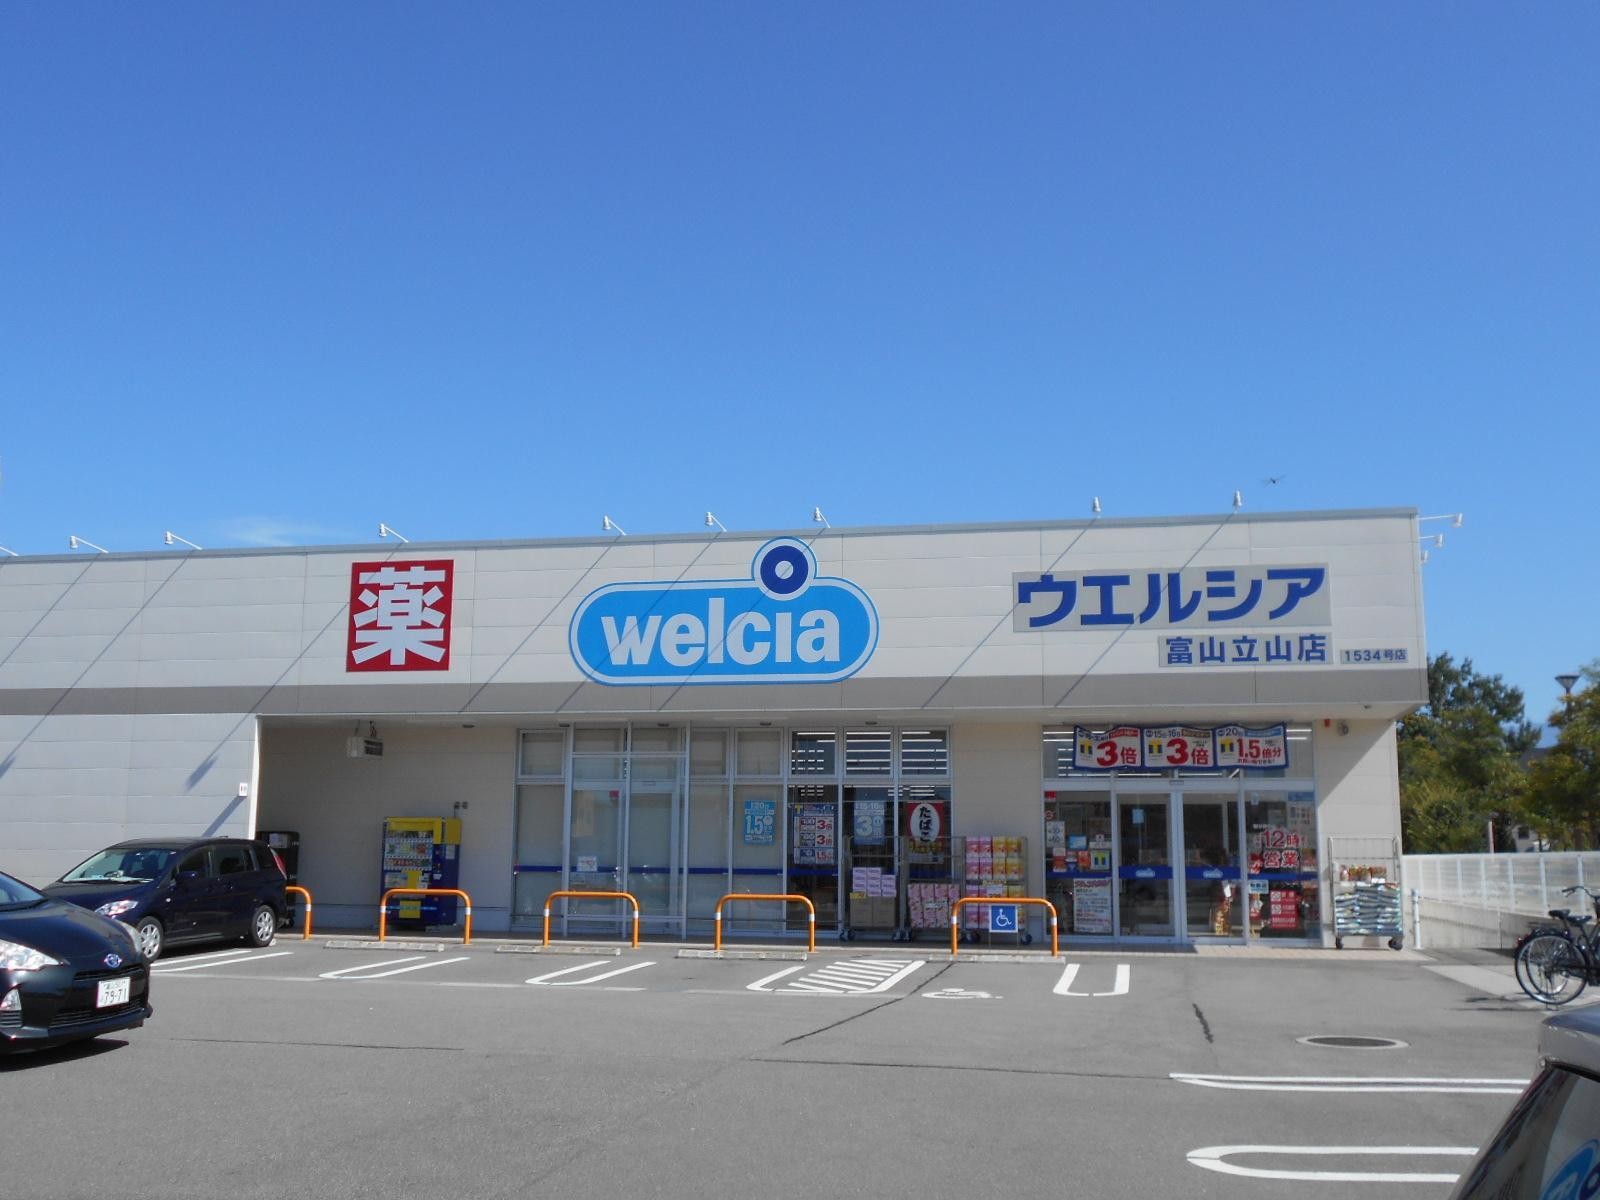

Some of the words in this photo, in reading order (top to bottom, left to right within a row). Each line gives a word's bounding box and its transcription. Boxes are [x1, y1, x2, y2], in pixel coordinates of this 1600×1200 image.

[352, 566, 446, 665] 薬
[601, 545, 840, 667] welcia
[1018, 567, 1325, 628] ウエルシア
[1165, 633, 1327, 665] 富山立山店
[1344, 649, 1407, 662] 1534号店
[918, 806, 932, 842] たばこ
